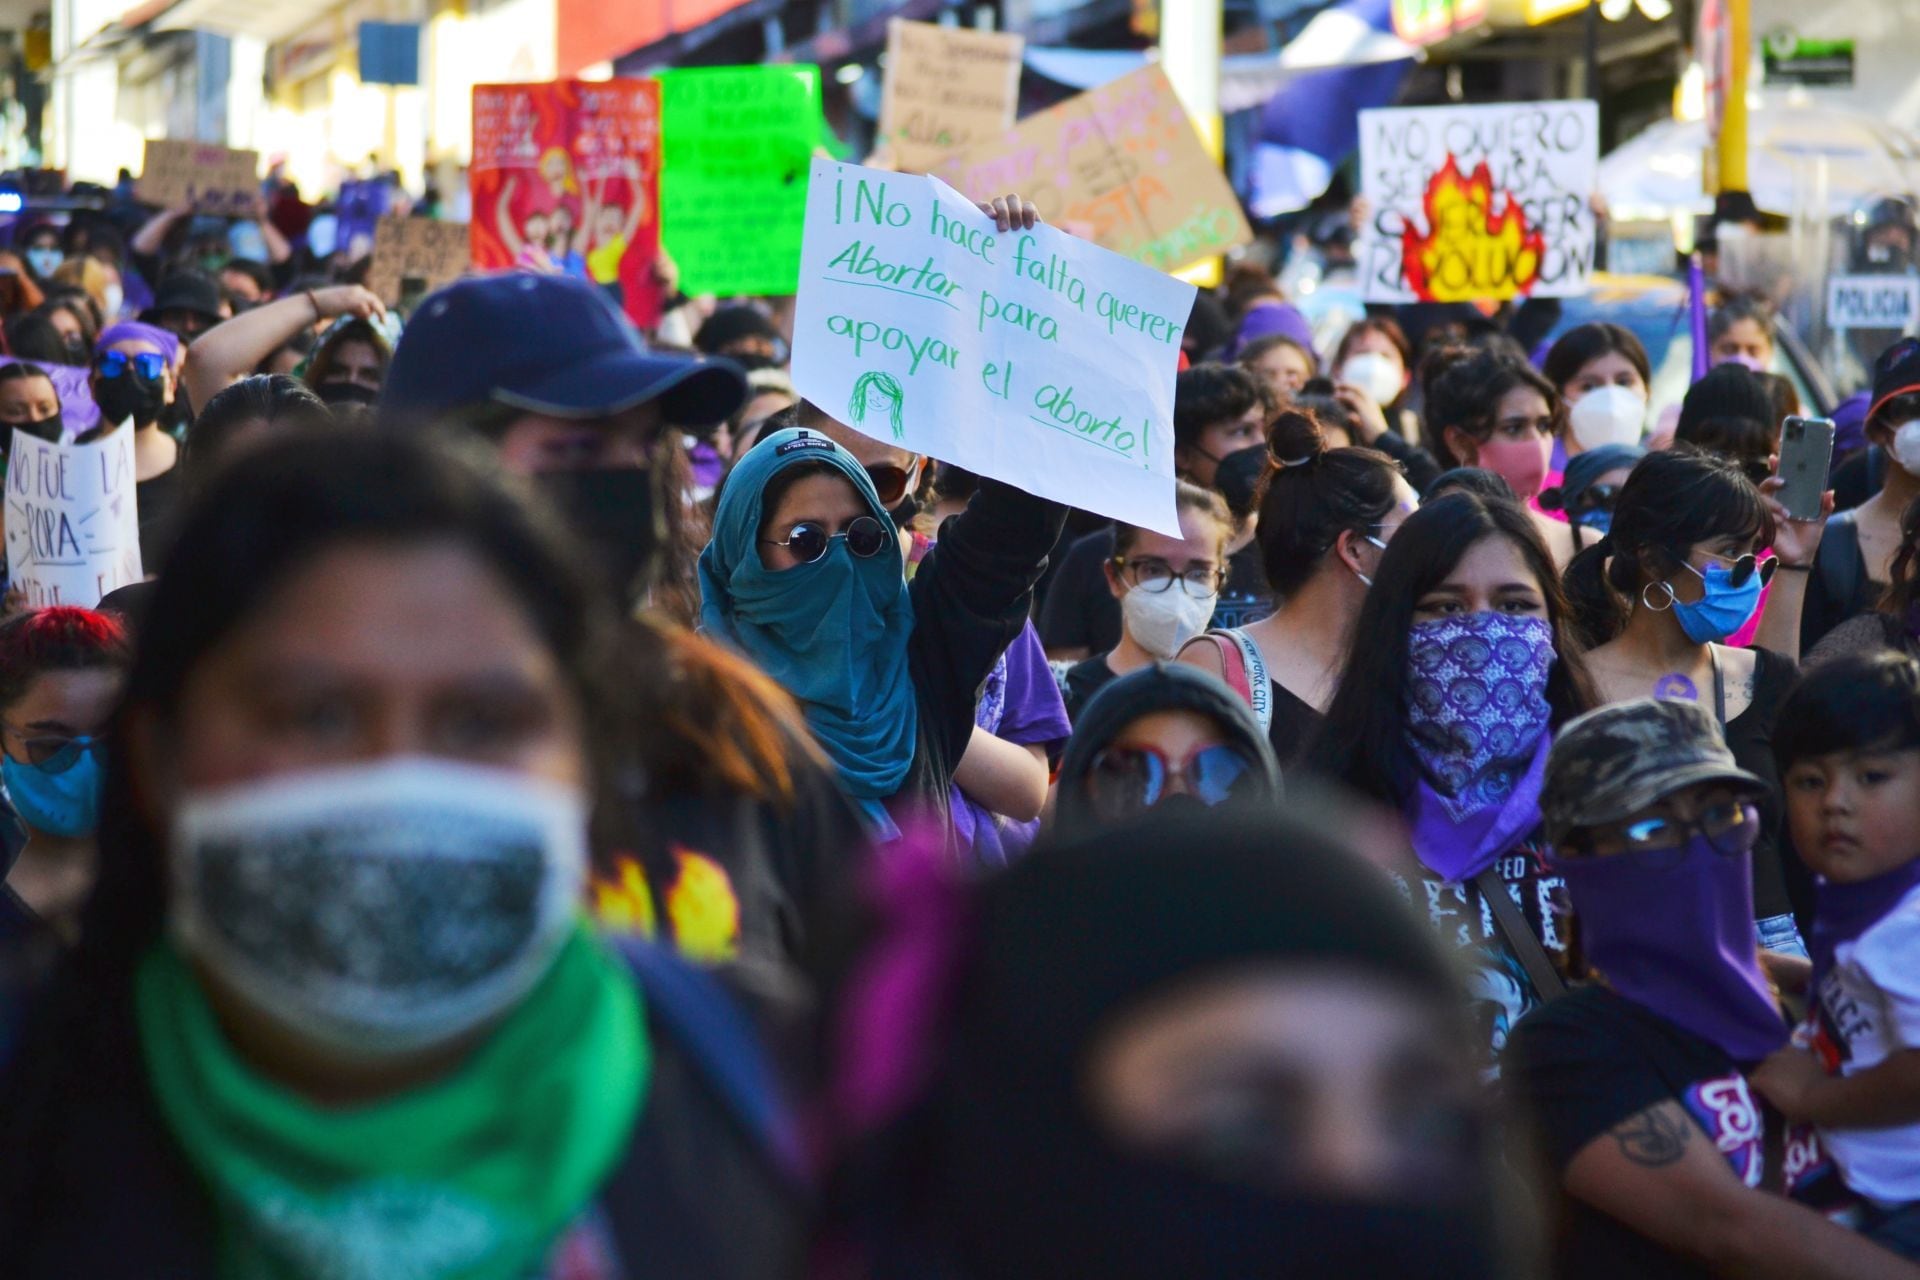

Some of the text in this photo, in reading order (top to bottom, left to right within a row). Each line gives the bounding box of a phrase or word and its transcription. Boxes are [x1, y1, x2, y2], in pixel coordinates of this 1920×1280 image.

[1376, 110, 1585, 162] NO QUIERO
[1519, 191, 1583, 237] SER
[828, 239, 1060, 343] Abortar para
[930, 199, 996, 265] hace
[1012, 234, 1086, 313] falta
[1095, 290, 1184, 345] querer
[826, 314, 1151, 471] apoyar el aborto!
[8, 436, 130, 501] NO FUE LA
[25, 502, 81, 559] ROPA
[1252, 689, 1267, 714] CITY
